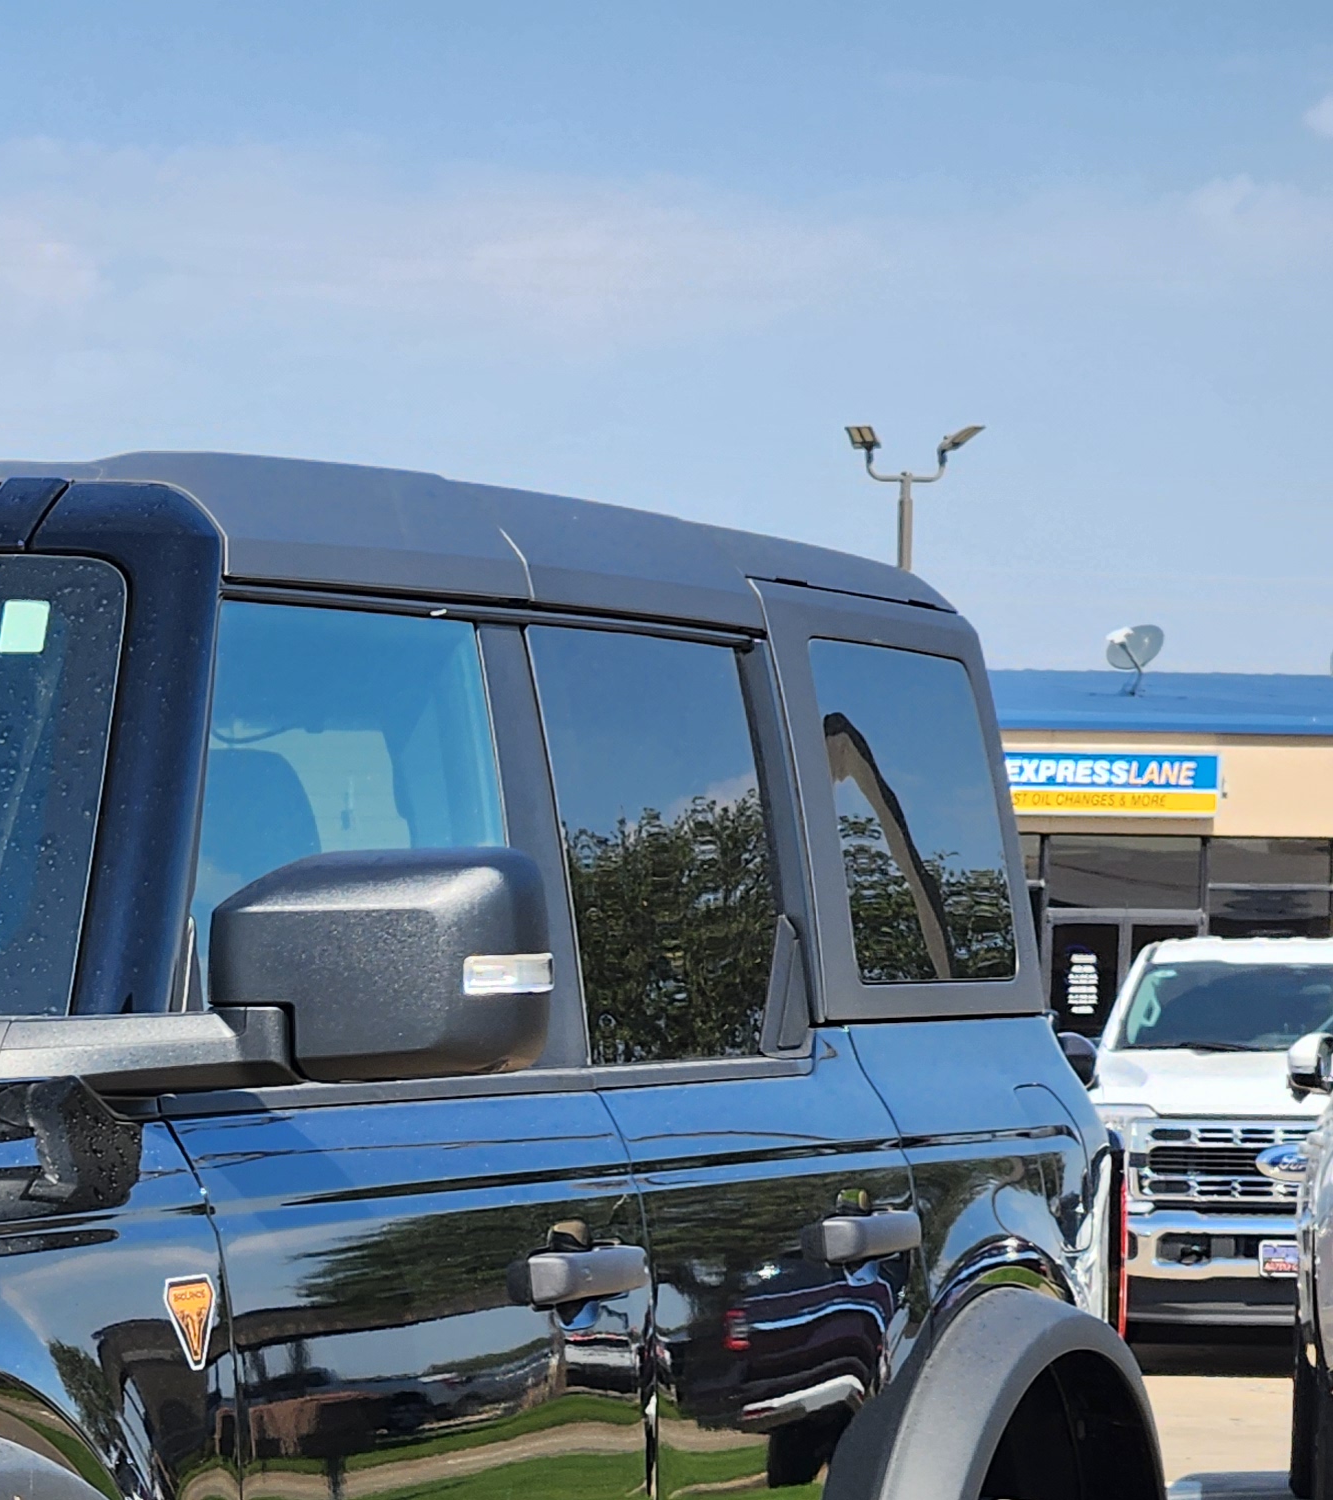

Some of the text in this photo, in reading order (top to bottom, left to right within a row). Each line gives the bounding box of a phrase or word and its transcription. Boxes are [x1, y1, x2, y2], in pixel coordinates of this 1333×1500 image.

[1031, 794, 1052, 806] OIL
[1056, 794, 1116, 808] CHANGES
[1130, 795, 1167, 808] MORE
